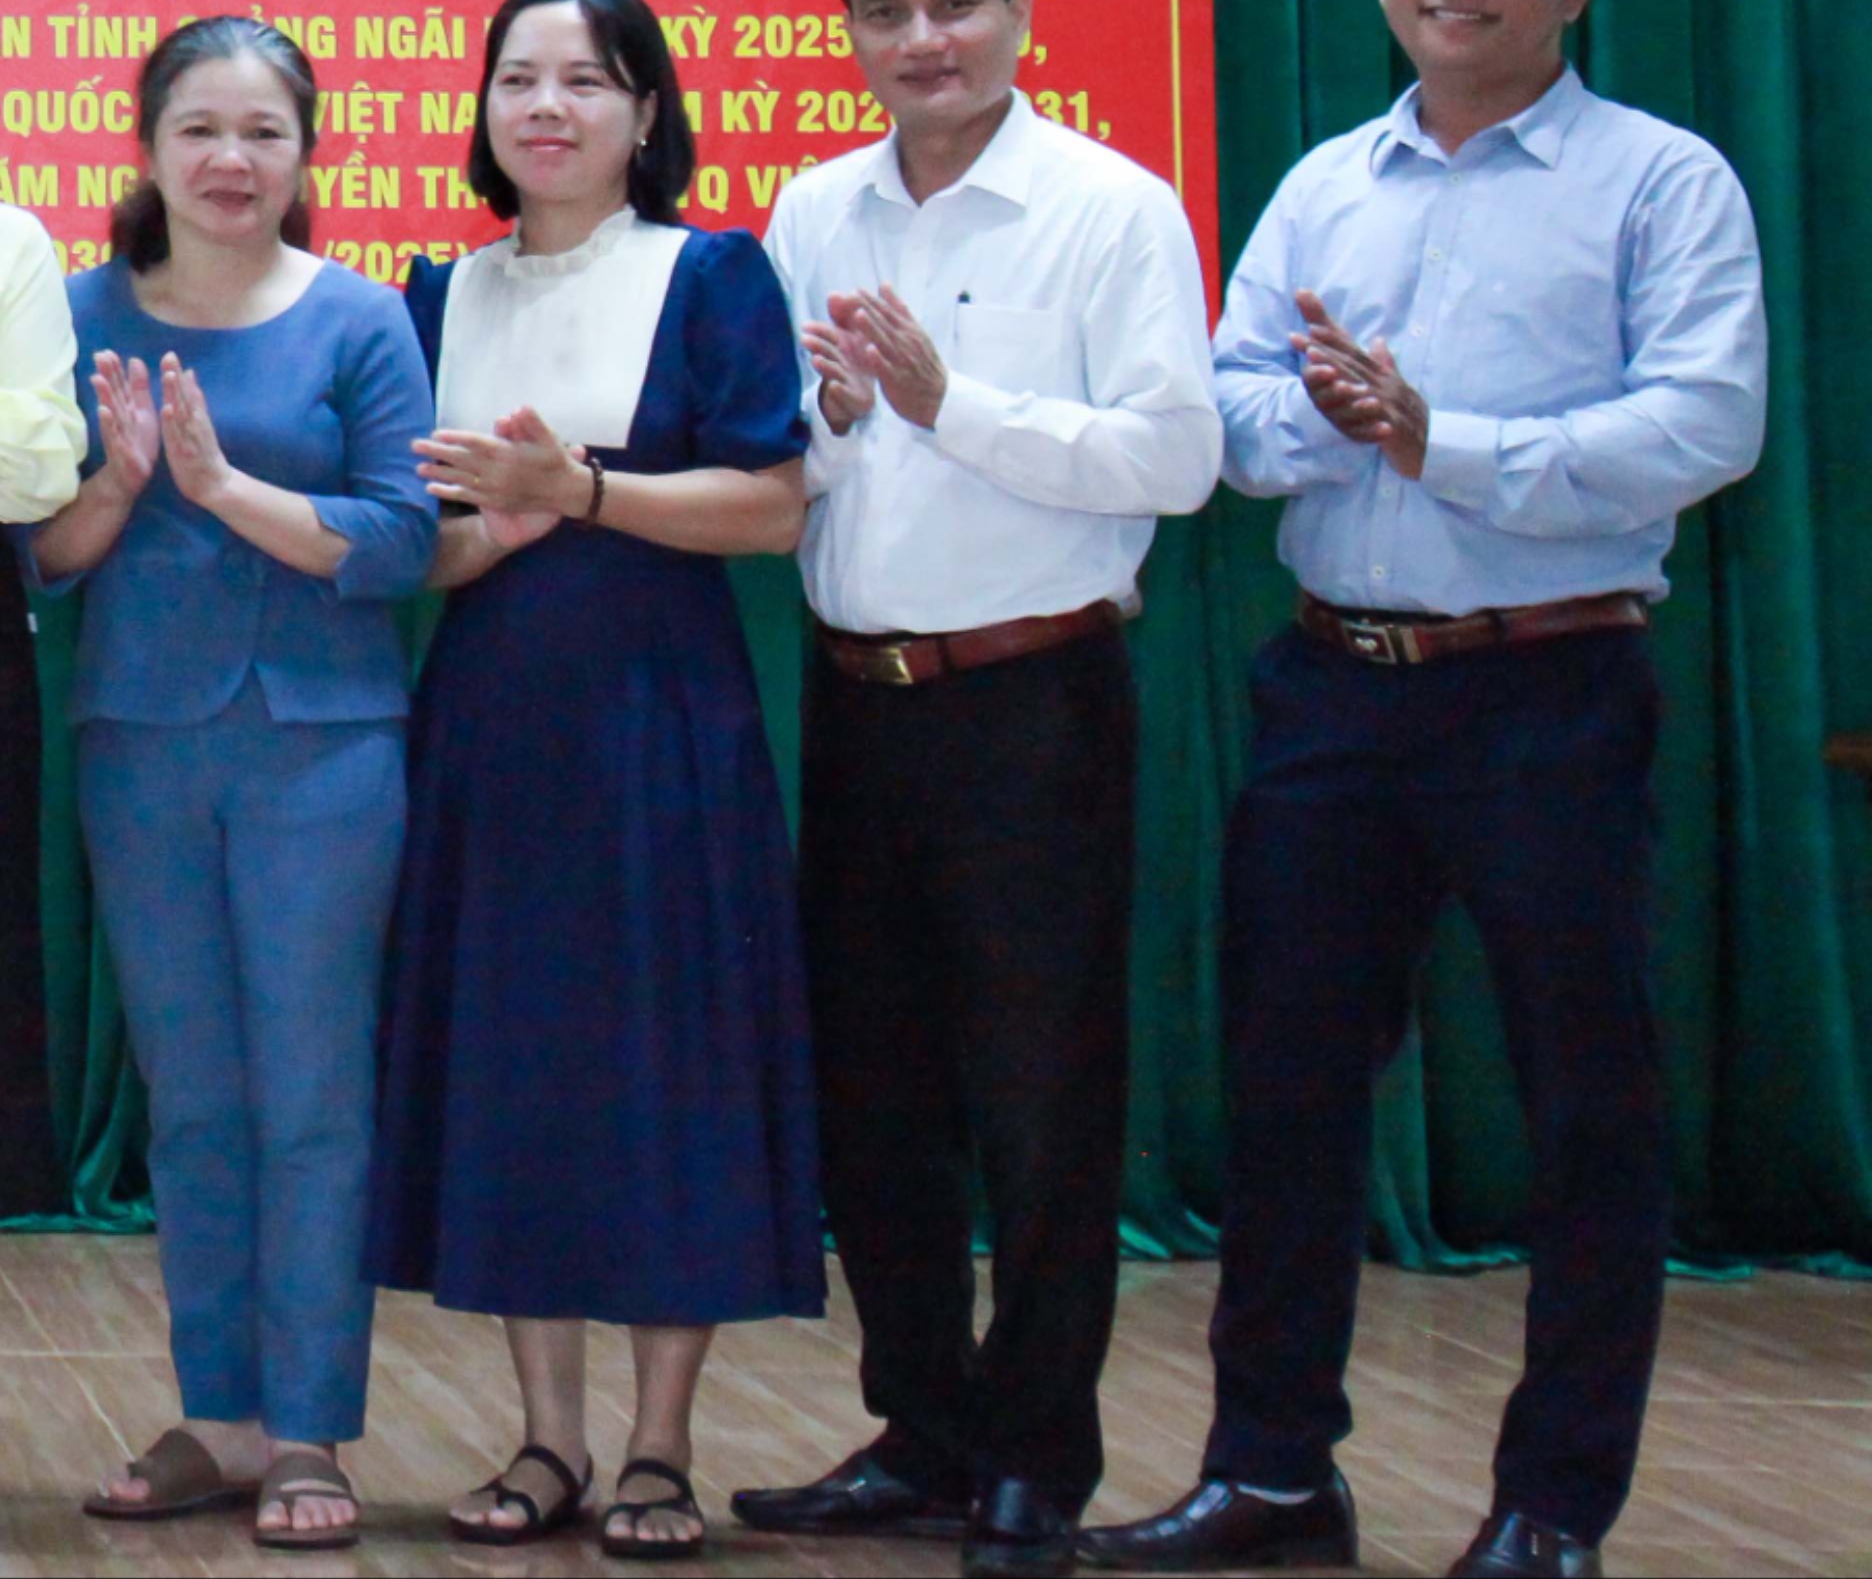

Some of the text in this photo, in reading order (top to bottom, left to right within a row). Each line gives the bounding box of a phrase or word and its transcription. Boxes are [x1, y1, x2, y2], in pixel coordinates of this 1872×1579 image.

[47, 3, 159, 58] TỈNH
[354, 7, 466, 59] NGÃI
[658, 4, 719, 59] KỲ
[2, 76, 135, 137] QUỐC
[420, 91, 479, 134] NA
[720, 79, 781, 133] KỲ
[795, 89, 897, 134] 202
